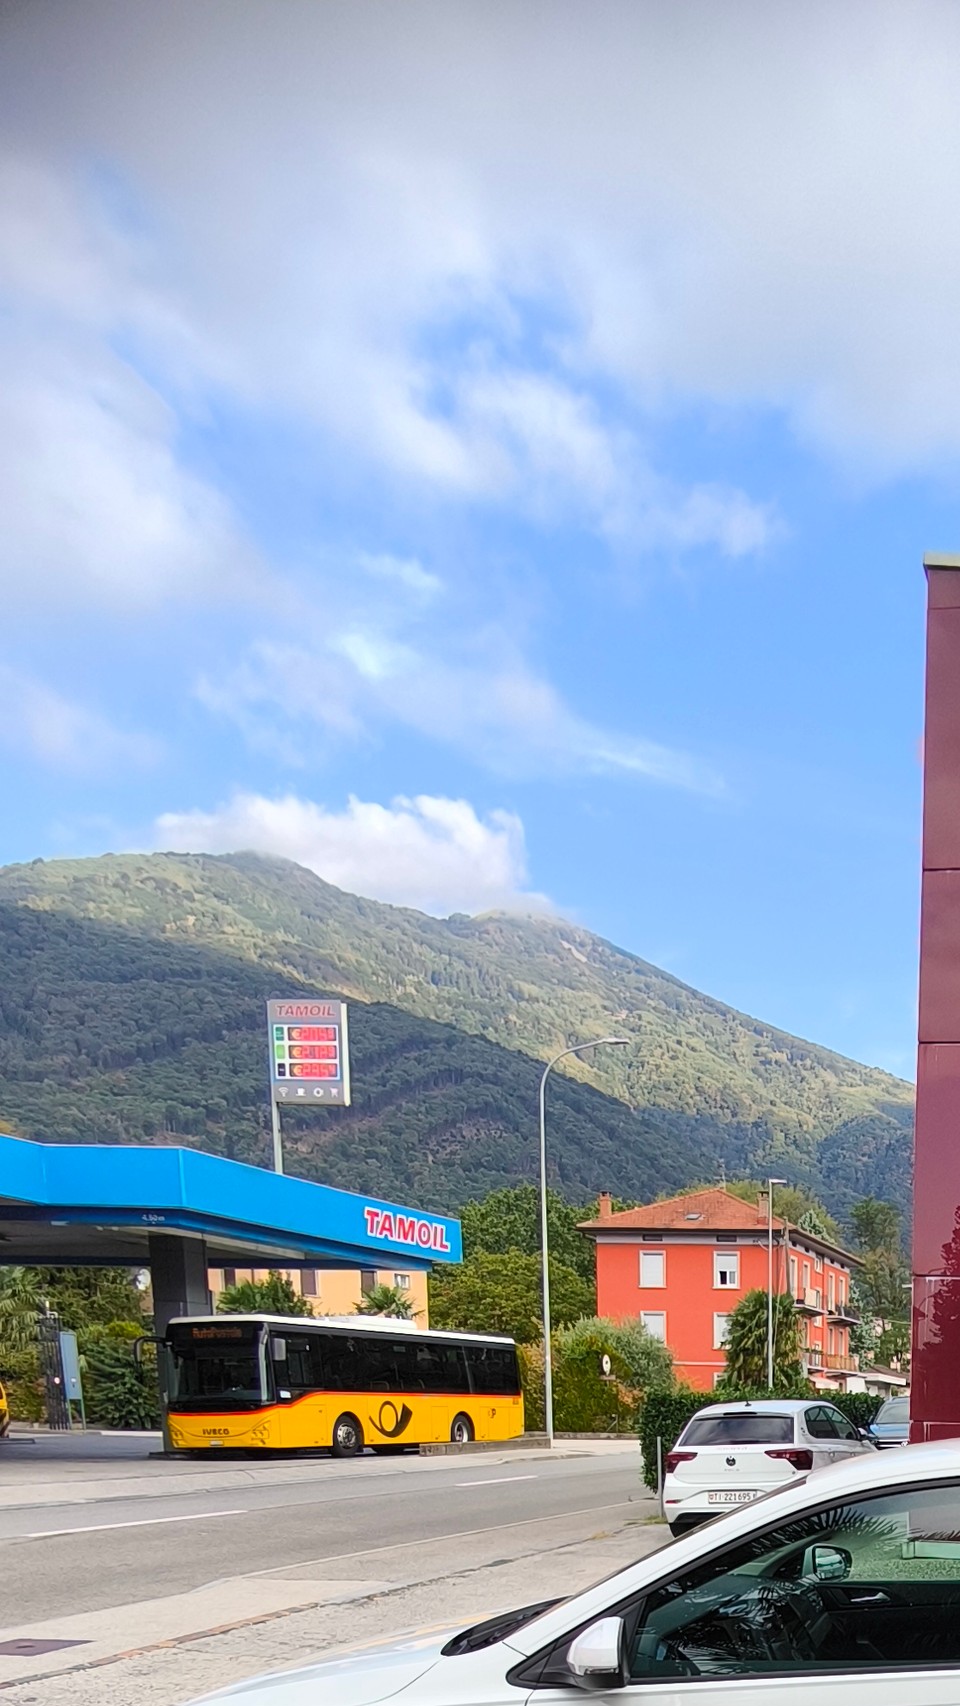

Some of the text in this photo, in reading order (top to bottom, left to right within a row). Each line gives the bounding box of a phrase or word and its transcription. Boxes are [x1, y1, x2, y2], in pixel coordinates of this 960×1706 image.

[276, 1005, 336, 1016] TAMOIL
[365, 1207, 450, 1251] TAMOIL
[202, 1428, 230, 1436] IVECO
